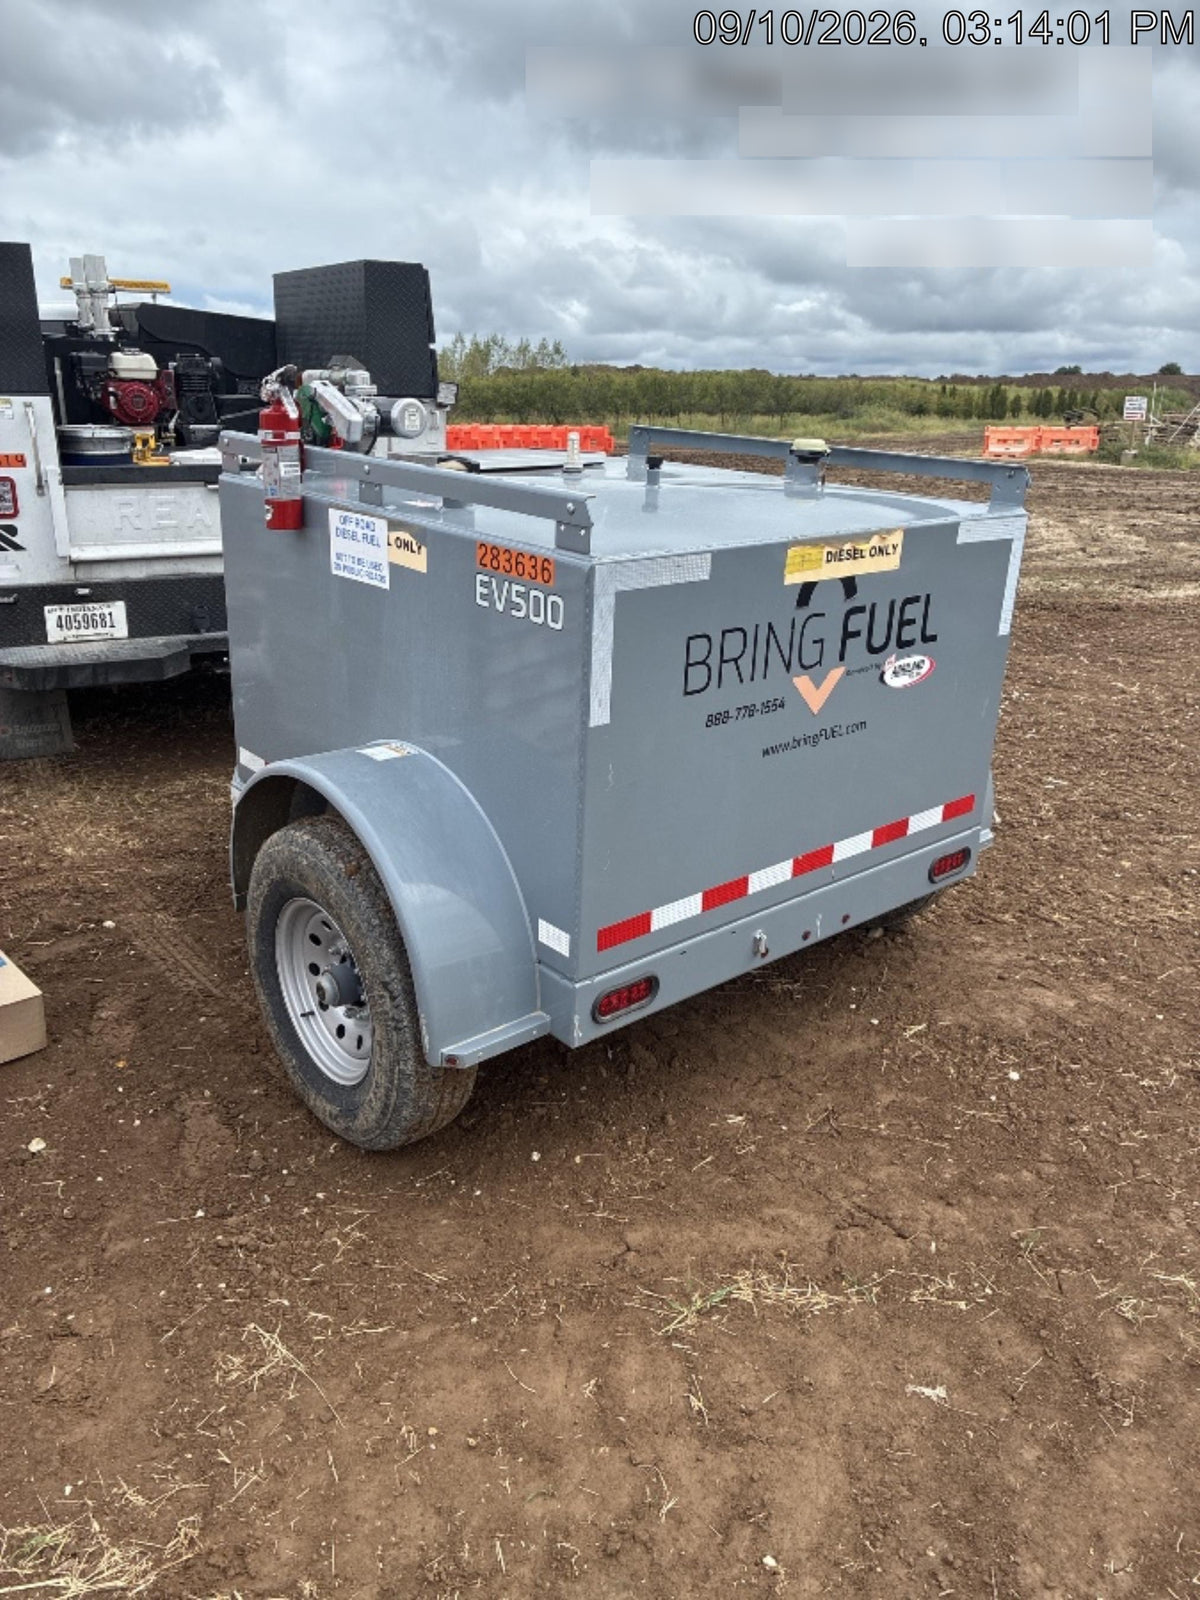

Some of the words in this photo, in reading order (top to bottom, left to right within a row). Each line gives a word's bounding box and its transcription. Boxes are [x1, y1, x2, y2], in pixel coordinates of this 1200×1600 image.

[335, 526, 361, 543] DIESEL
[362, 533, 381, 548] FUEL
[395, 536, 422, 555] ONLY
[478, 543, 552, 584] 283636
[825, 547, 866, 564] DIESEL
[868, 543, 899, 558] ONLY
[475, 573, 565, 631] EV500
[56, 610, 116, 631] 4059681
[683, 612, 826, 696] BRING
[838, 594, 938, 662] FUEL
